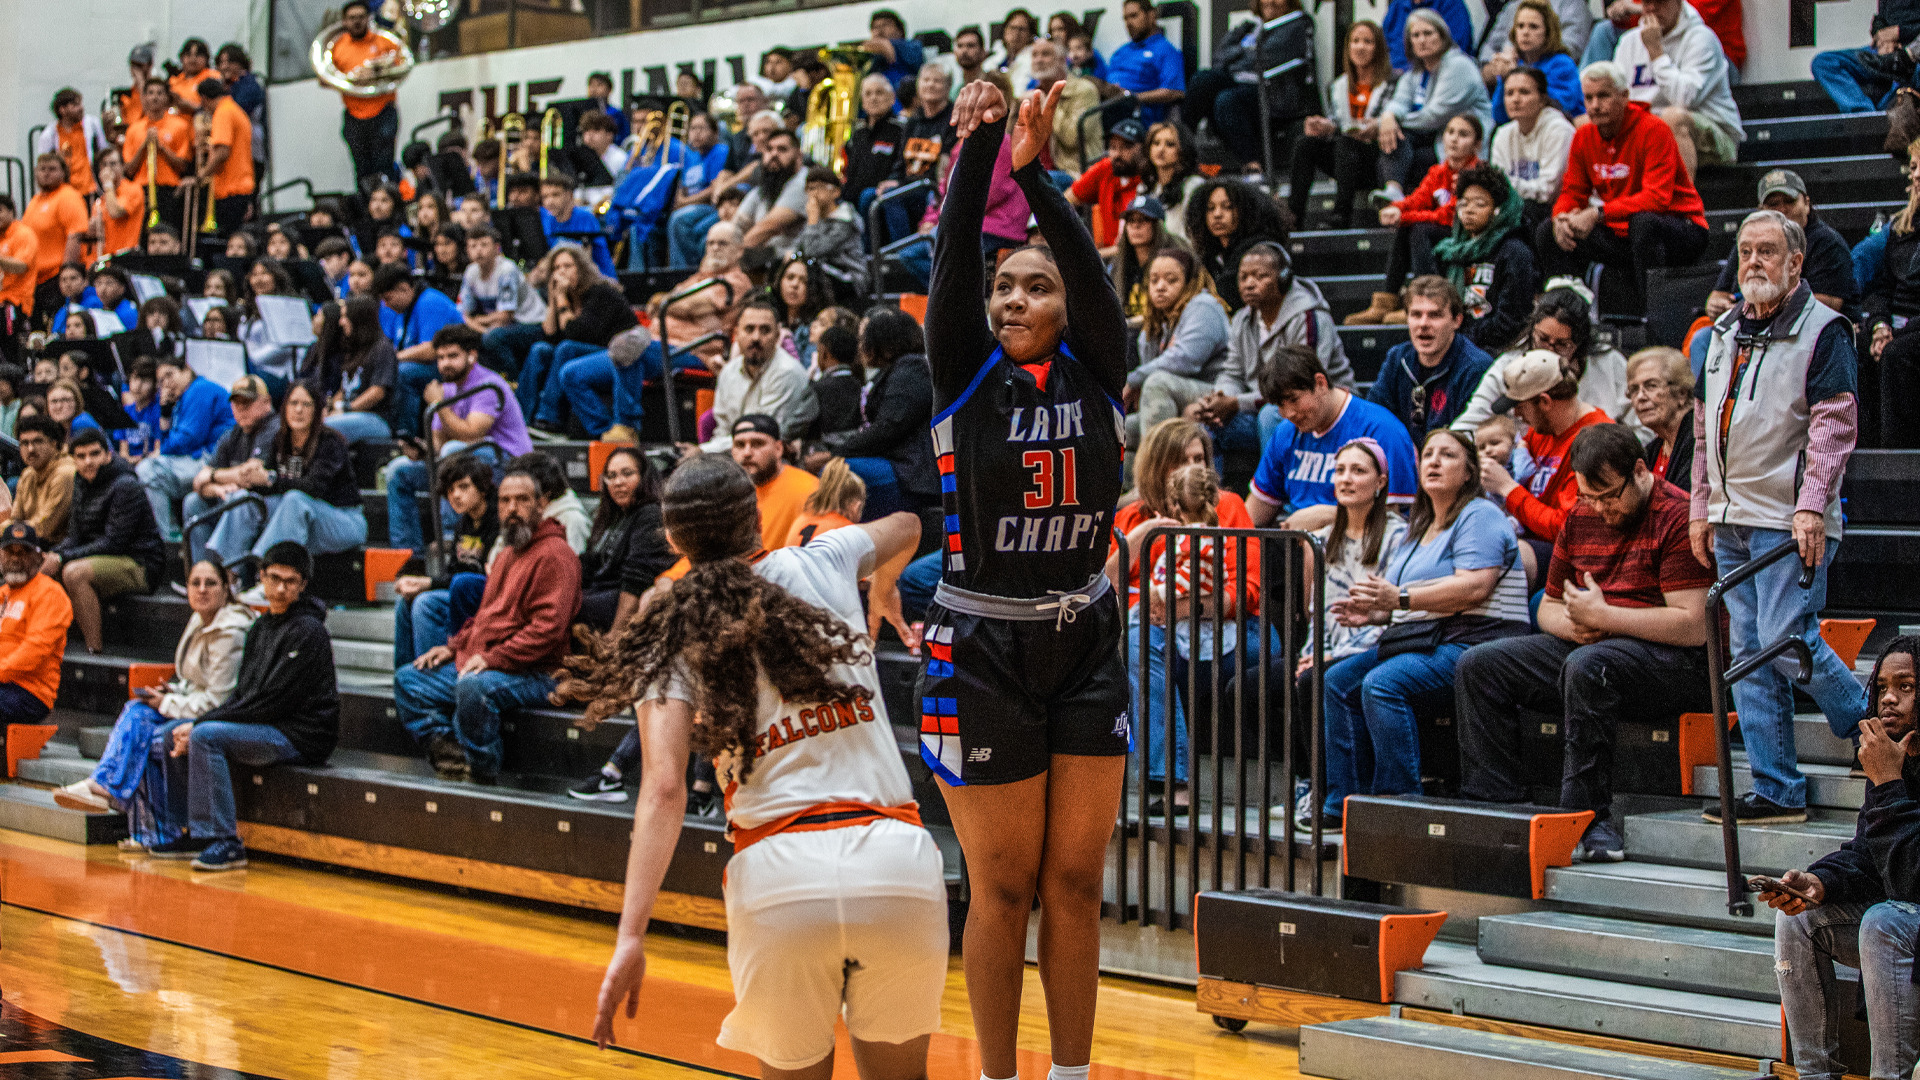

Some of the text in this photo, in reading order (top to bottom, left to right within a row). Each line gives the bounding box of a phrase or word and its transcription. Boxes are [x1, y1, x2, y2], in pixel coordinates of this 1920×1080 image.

[1007, 399, 1085, 441] LADY
[1022, 447, 1080, 509] 31
[755, 697, 875, 758] FALCONS
